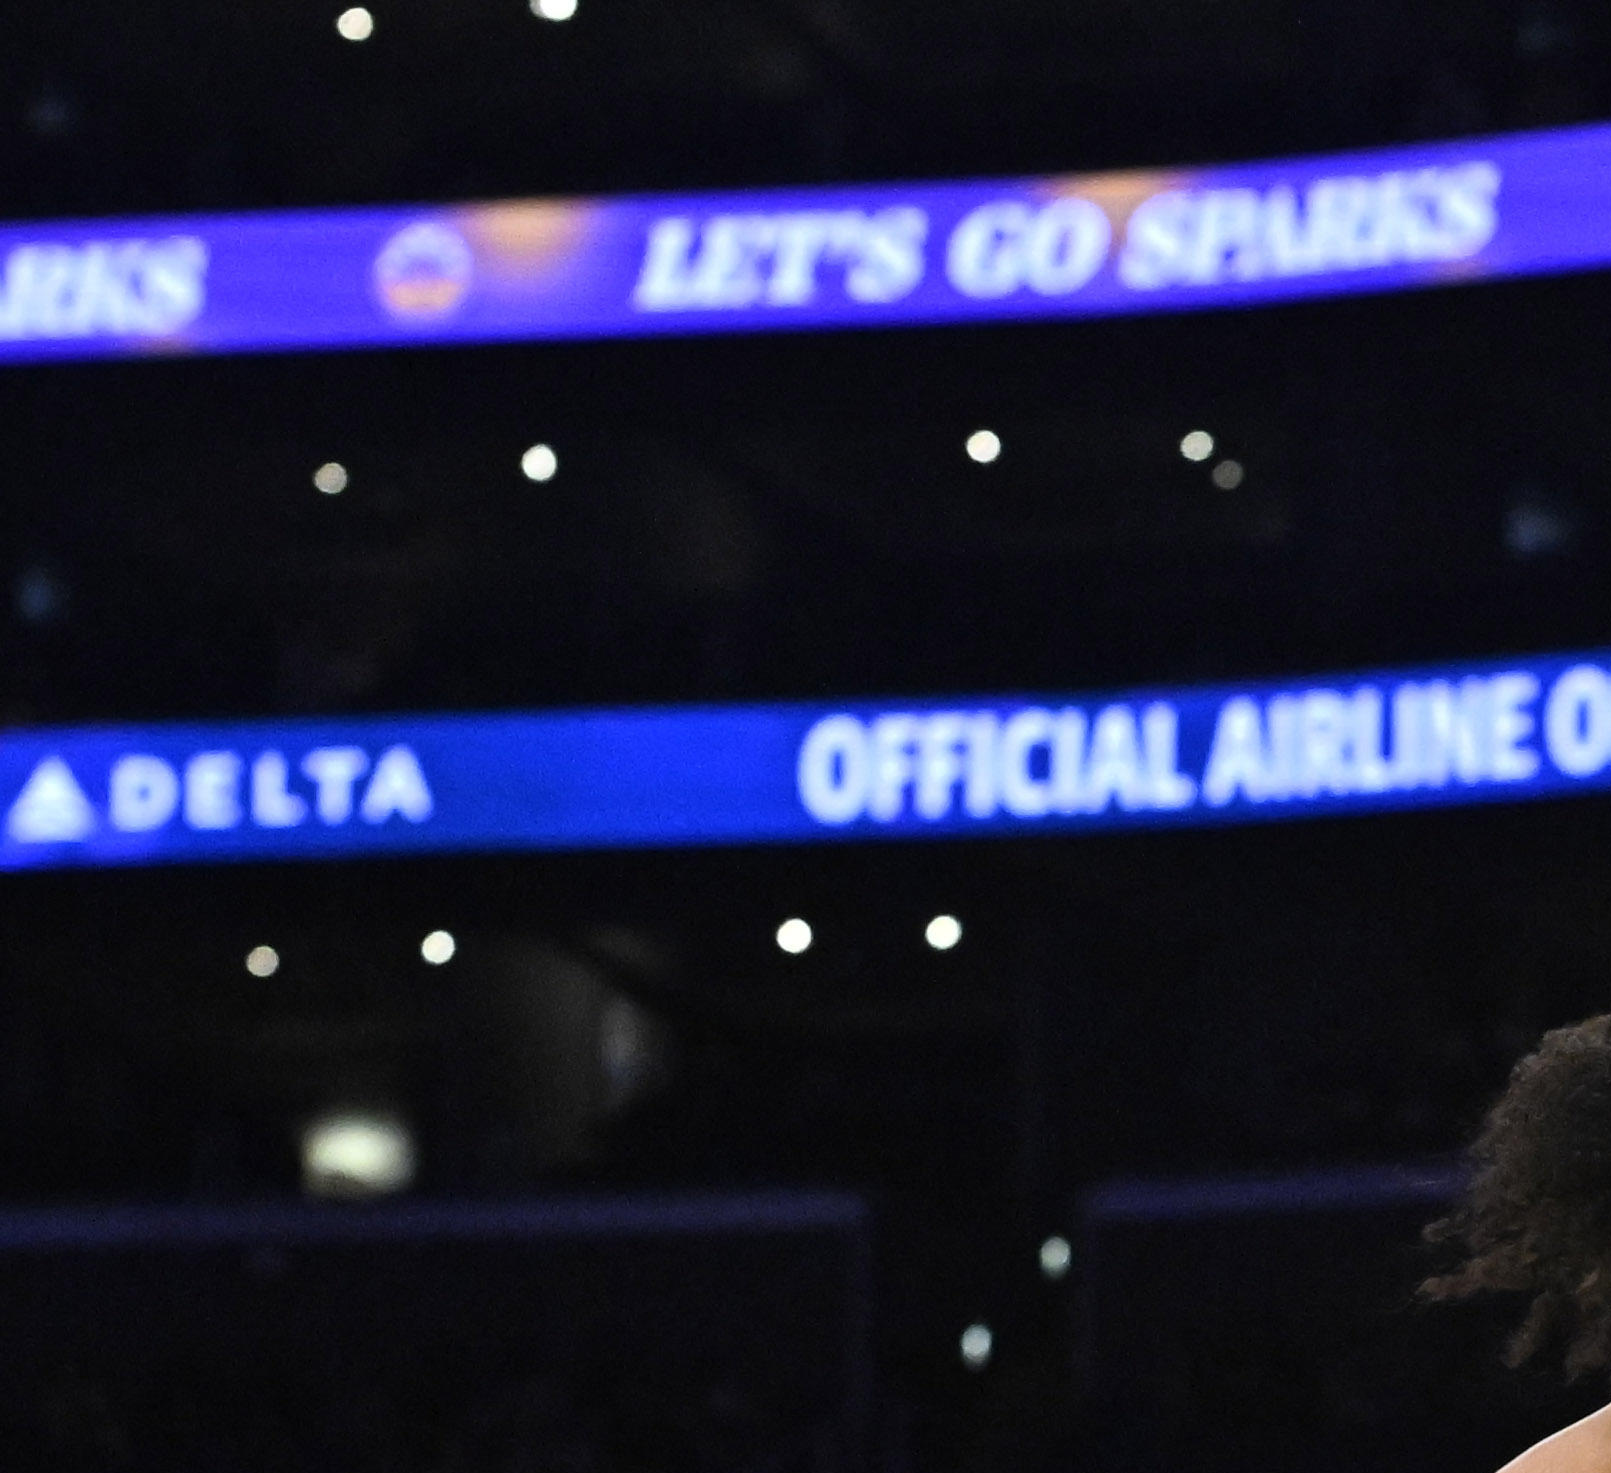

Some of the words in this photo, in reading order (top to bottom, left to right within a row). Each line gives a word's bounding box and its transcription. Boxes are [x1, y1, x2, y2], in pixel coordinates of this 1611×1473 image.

[634, 208, 926, 311] LET'S
[946, 196, 1111, 297] GO
[1116, 162, 1500, 289] SPARKS
[108, 746, 433, 830] DELTA
[799, 702, 1197, 823] OFFICIAL
[1203, 672, 1539, 803] AIRLINE
